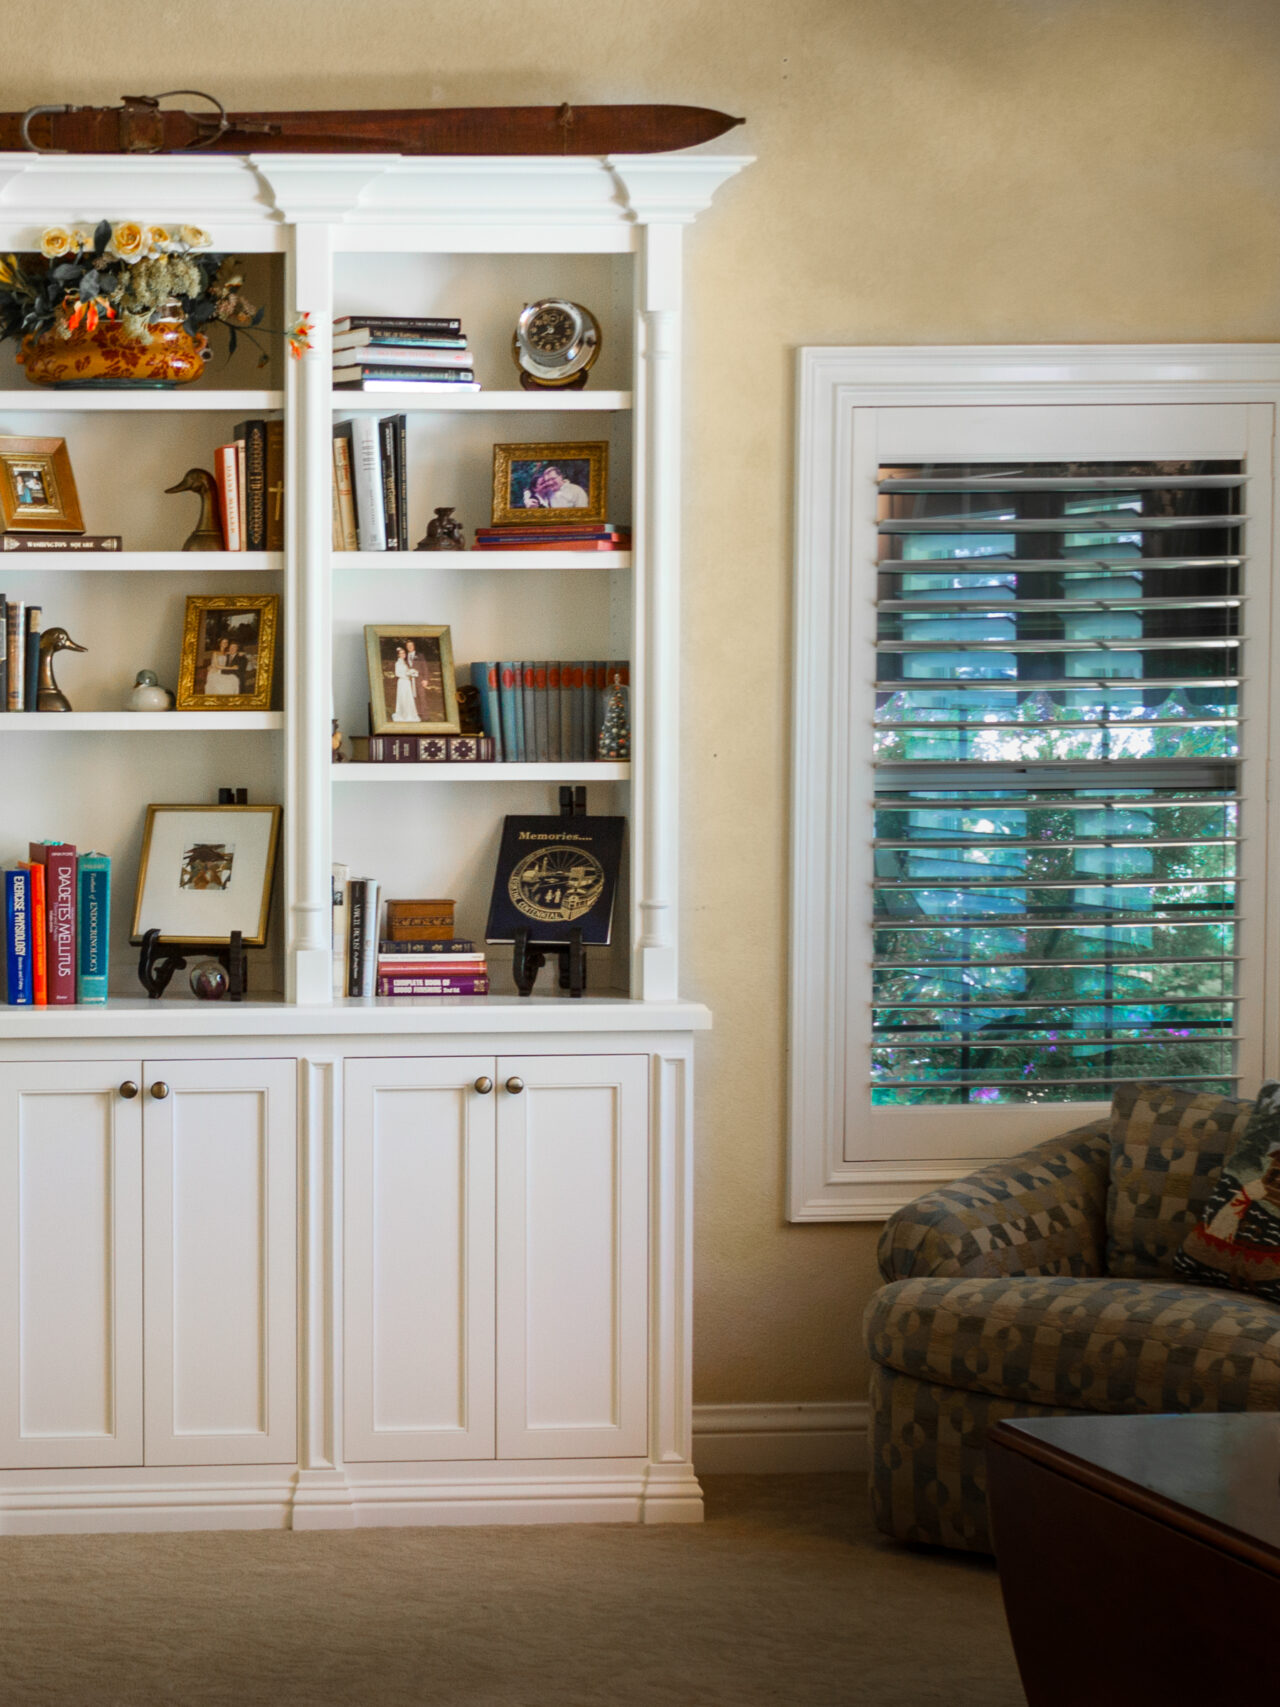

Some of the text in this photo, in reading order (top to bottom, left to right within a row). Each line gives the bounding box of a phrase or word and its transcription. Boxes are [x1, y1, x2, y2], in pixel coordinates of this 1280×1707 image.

[13, 876, 26, 956] EXERCISE PHYSIOLOGY
[58, 866, 71, 921] DIABETES
[58, 924, 71, 978] MELLITUS
[89, 902, 98, 973] ENDOCRINOLOGY
